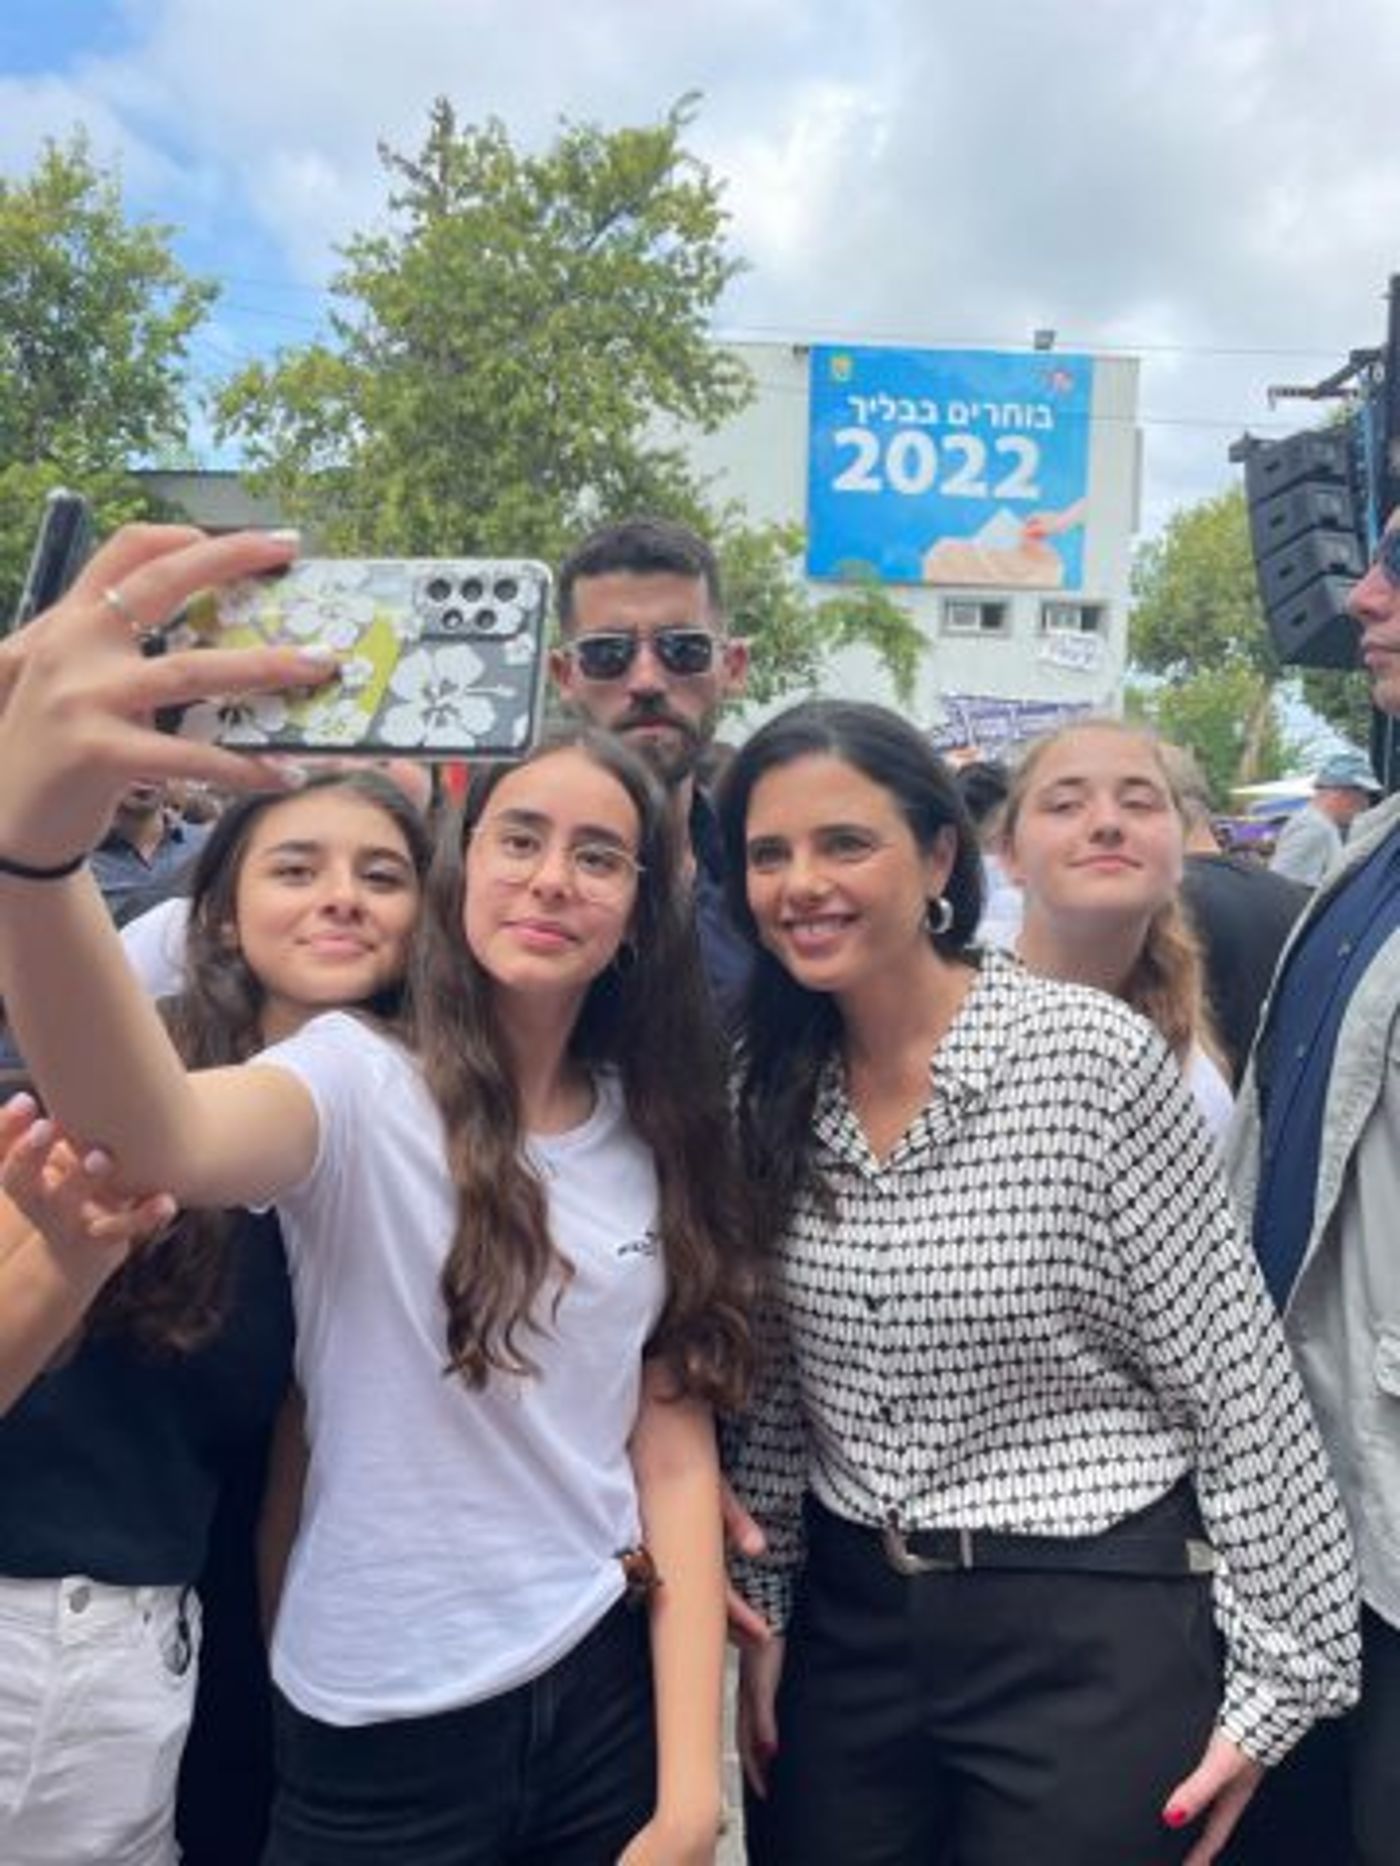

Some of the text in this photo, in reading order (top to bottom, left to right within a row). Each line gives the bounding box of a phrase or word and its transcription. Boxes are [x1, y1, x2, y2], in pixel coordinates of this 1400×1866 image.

[848, 392, 1053, 428] בוחרים בבליך
[833, 427, 1039, 498] 2022
